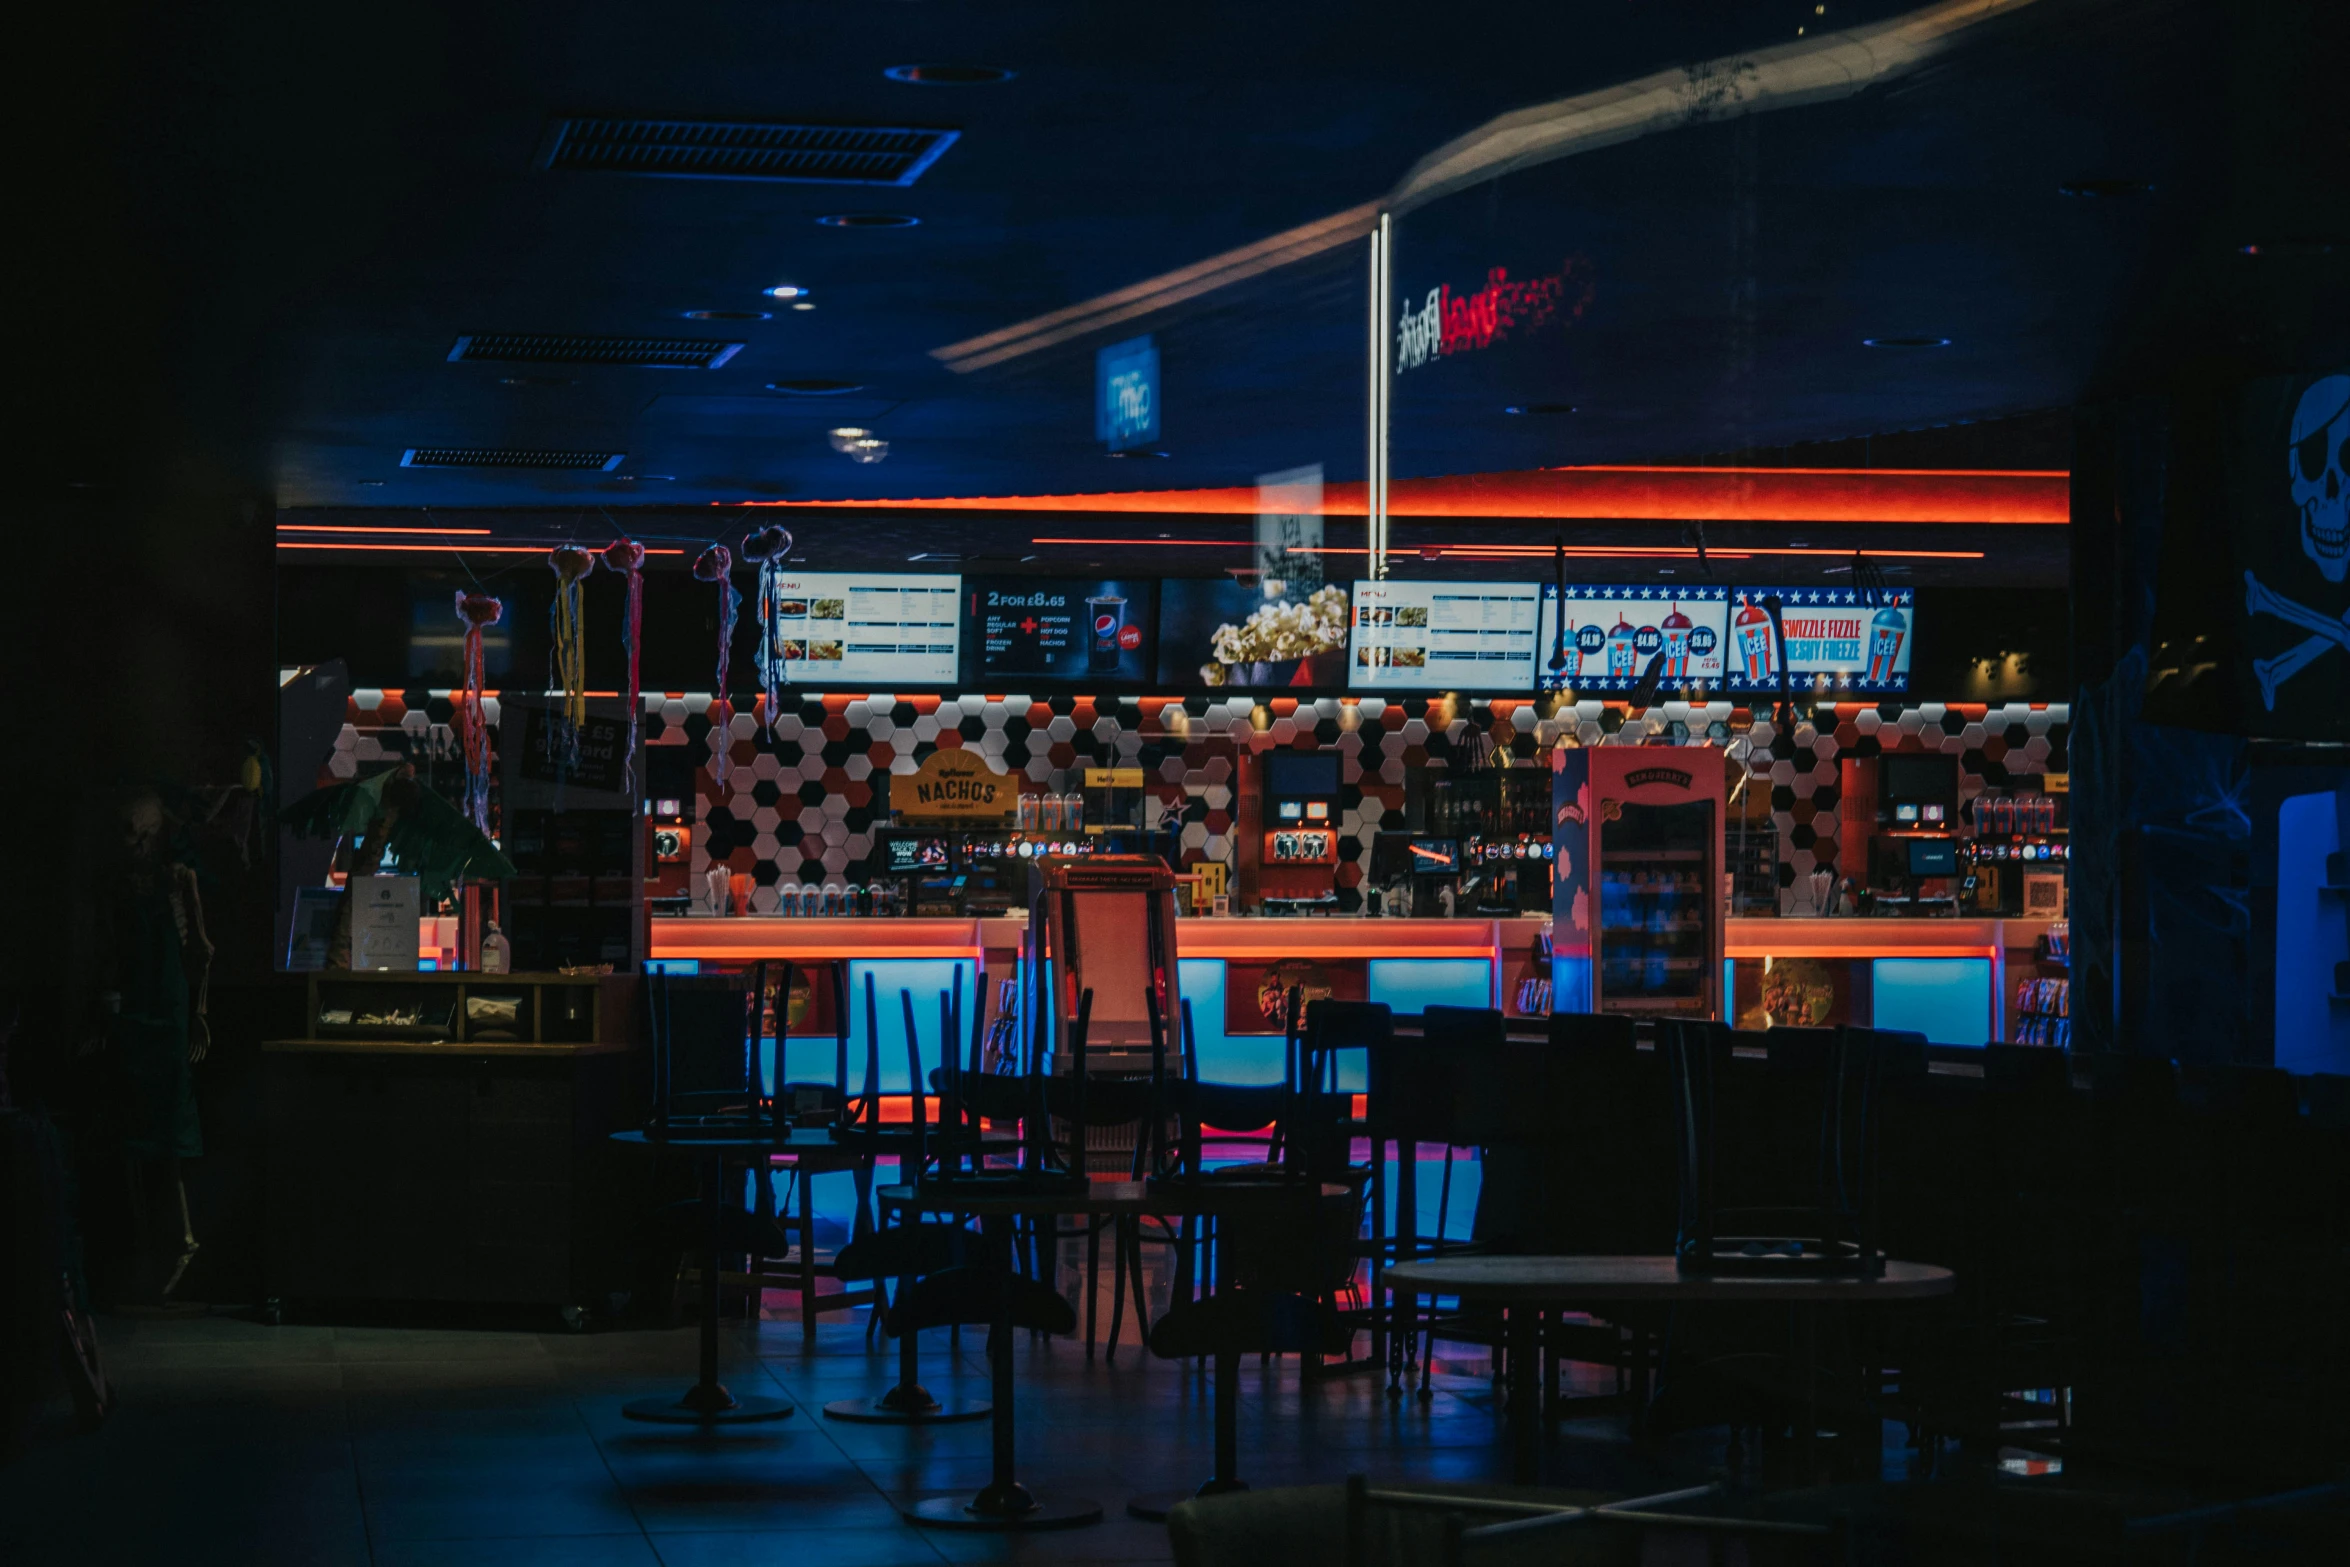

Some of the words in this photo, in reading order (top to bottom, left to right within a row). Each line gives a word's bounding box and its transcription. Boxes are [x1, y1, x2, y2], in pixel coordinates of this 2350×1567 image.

[987, 591, 999, 607] 2
[1001, 595, 1025, 607] FOR
[1027, 591, 1066, 607] £8.65
[1782, 619, 1826, 638] SWIZZLE
[1828, 619, 1861, 638] FIZZLE
[1665, 641, 1687, 658] ICEE
[1743, 635, 1768, 656] ICEE
[1822, 640, 1861, 660] FREEZE
[1873, 639, 1896, 656] ICEE
[1612, 652, 1634, 668] ICEE
[917, 780, 996, 804] NACHOS
